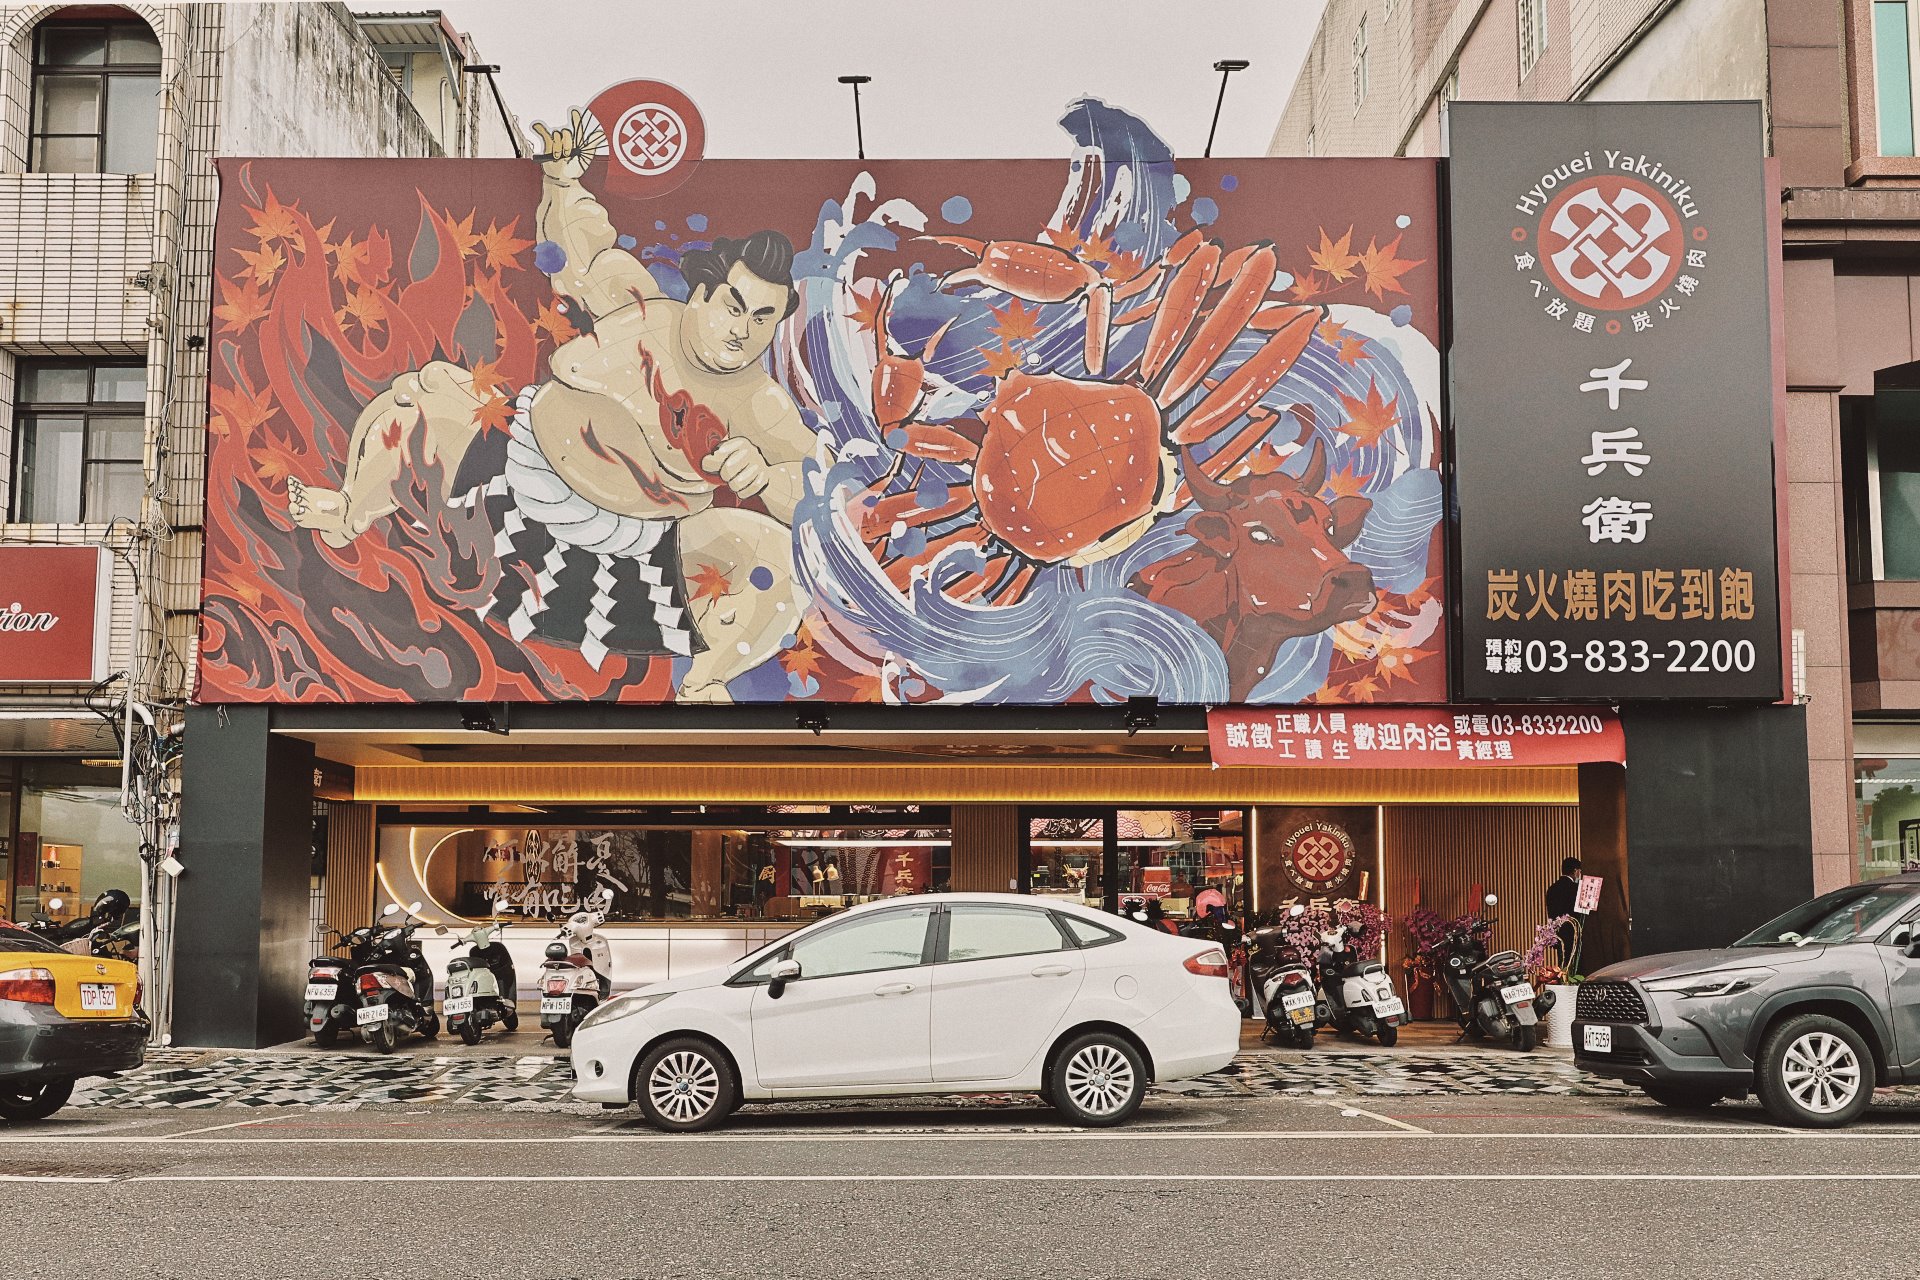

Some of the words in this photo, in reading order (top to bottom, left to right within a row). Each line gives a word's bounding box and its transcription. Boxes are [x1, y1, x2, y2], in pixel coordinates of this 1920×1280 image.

[1515, 151, 1593, 216] Hyouei
[1604, 150, 1699, 218] Yakiniku
[1513, 251, 1597, 333] 食べ放題
[1630, 249, 1707, 332] 炭火燒肉
[1579, 358, 1654, 543] 千兵衛
[1486, 567, 1755, 621] 炭火燒肉吃到飽
[1485, 638, 1522, 655] 預約
[1525, 639, 1756, 673] 03-833-2200
[1485, 656, 1522, 674] 專線
[1225, 722, 1274, 750] 誠徵
[1275, 712, 1347, 735] 正職人員
[1352, 722, 1451, 752] 歡迎內洽
[1278, 739, 1351, 761] 工讀生
[1285, 823, 1313, 847] Hyouei
[1316, 823, 1350, 848] Yakiniku
